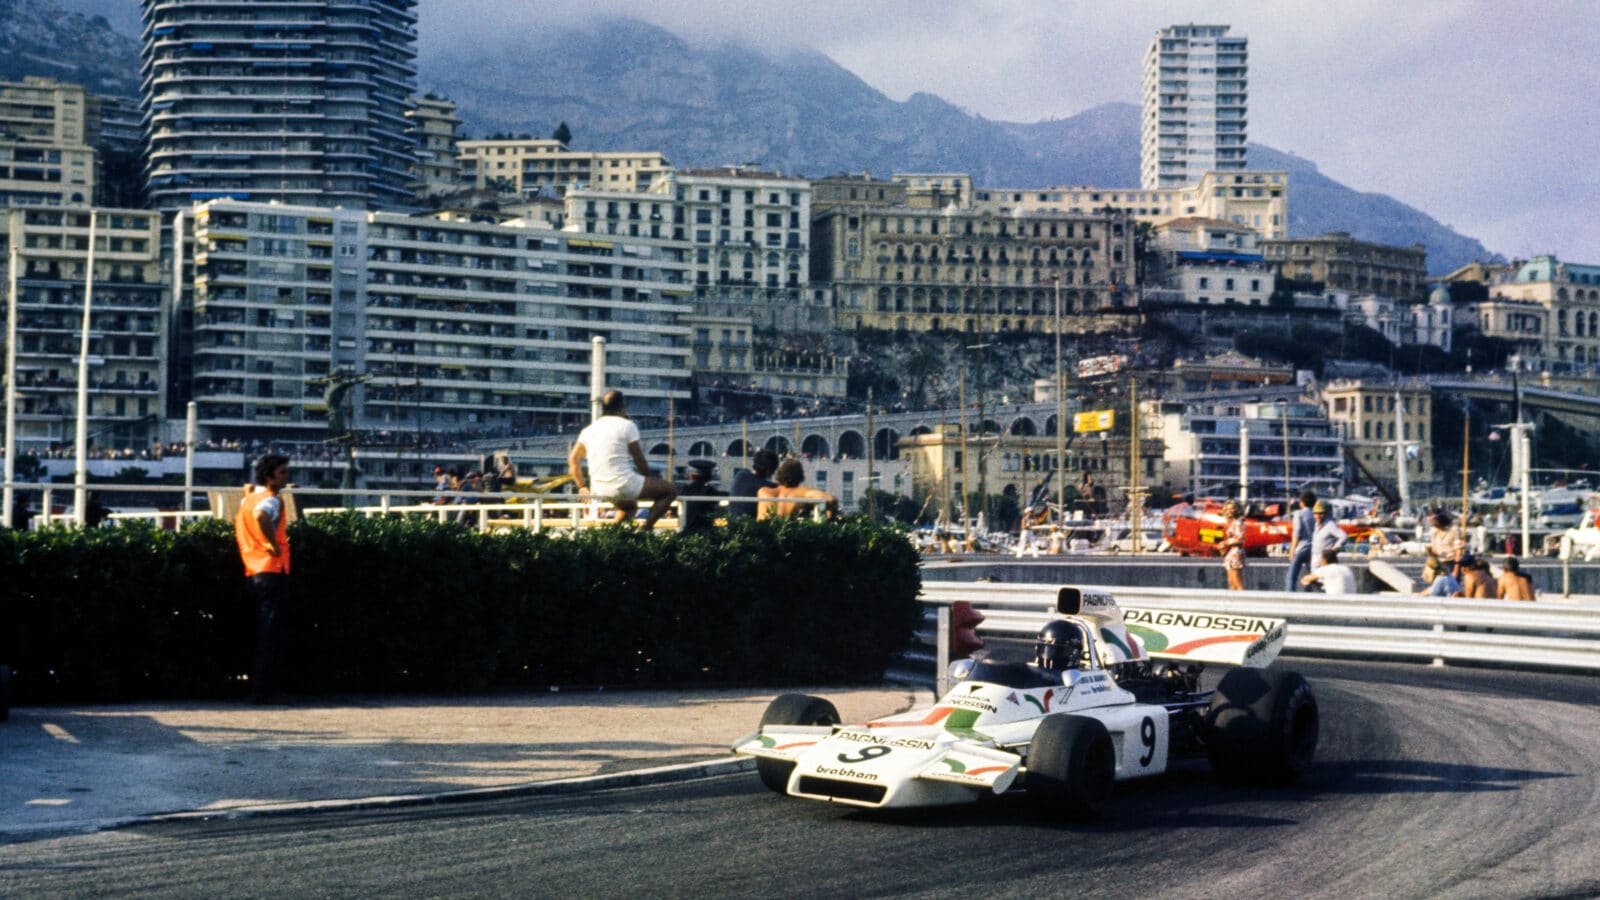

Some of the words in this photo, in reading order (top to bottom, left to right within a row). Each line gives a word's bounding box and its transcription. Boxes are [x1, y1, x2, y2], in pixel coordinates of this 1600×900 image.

[1123, 609, 1275, 633] PAGNOSSIN
[1139, 715, 1156, 768] 9
[837, 745, 892, 763] 9
[816, 765, 878, 781] brabham
